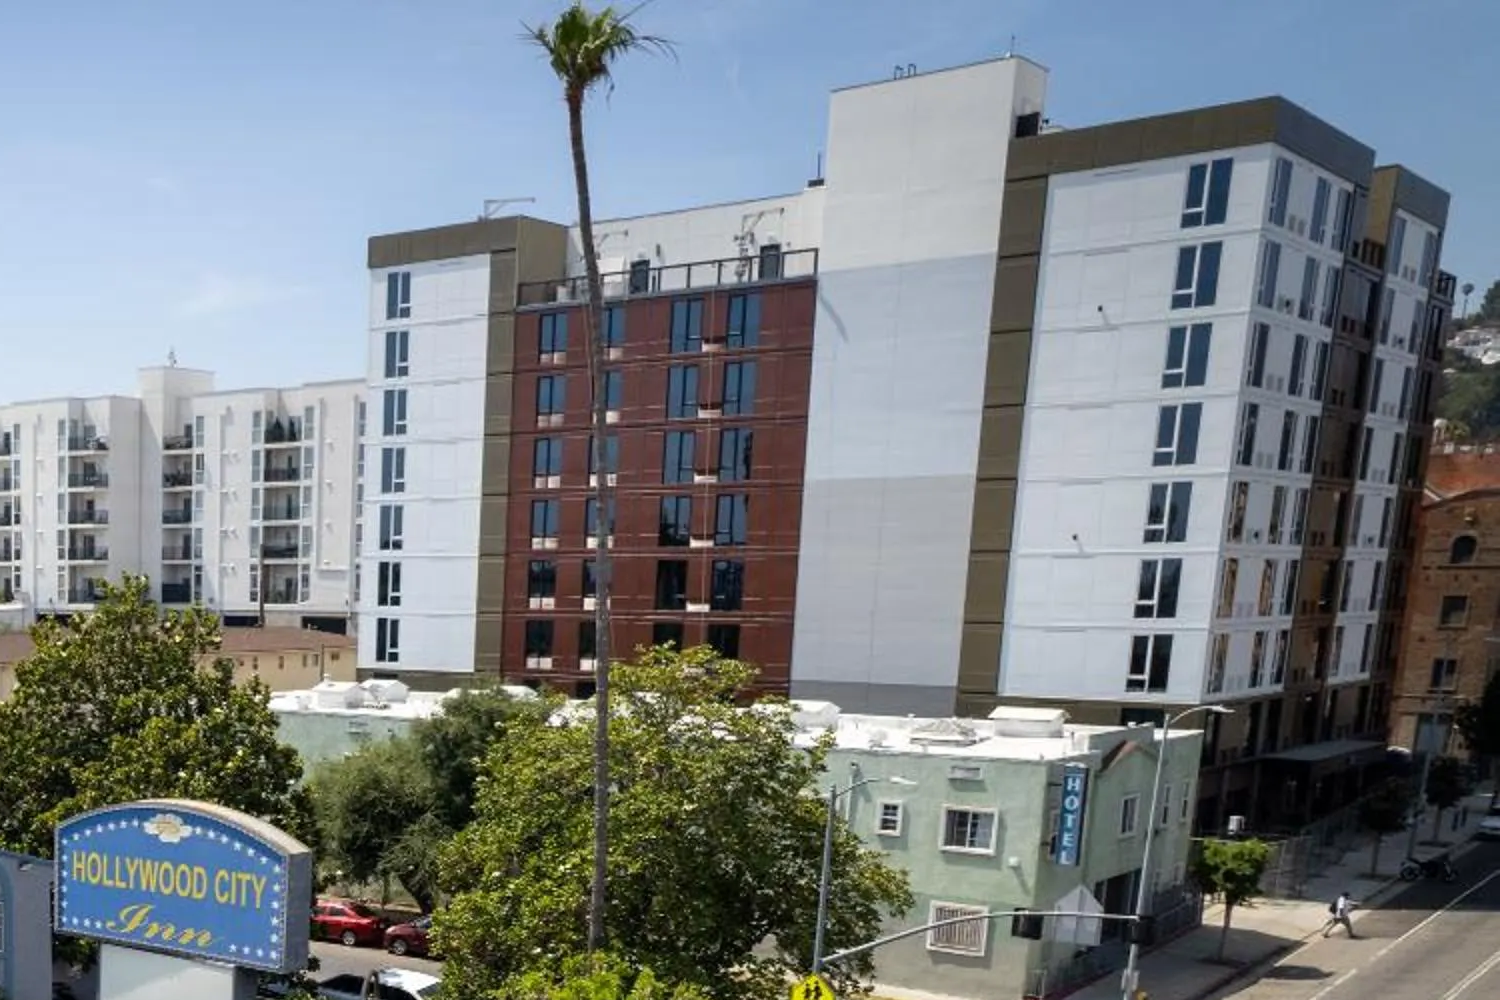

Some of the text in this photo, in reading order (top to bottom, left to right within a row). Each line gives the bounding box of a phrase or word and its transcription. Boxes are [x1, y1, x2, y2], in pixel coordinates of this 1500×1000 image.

[1059, 776, 1080, 865] HOTEL
[72, 850, 267, 909] HOLLYWOOD CITY
[106, 903, 222, 947] Inn
